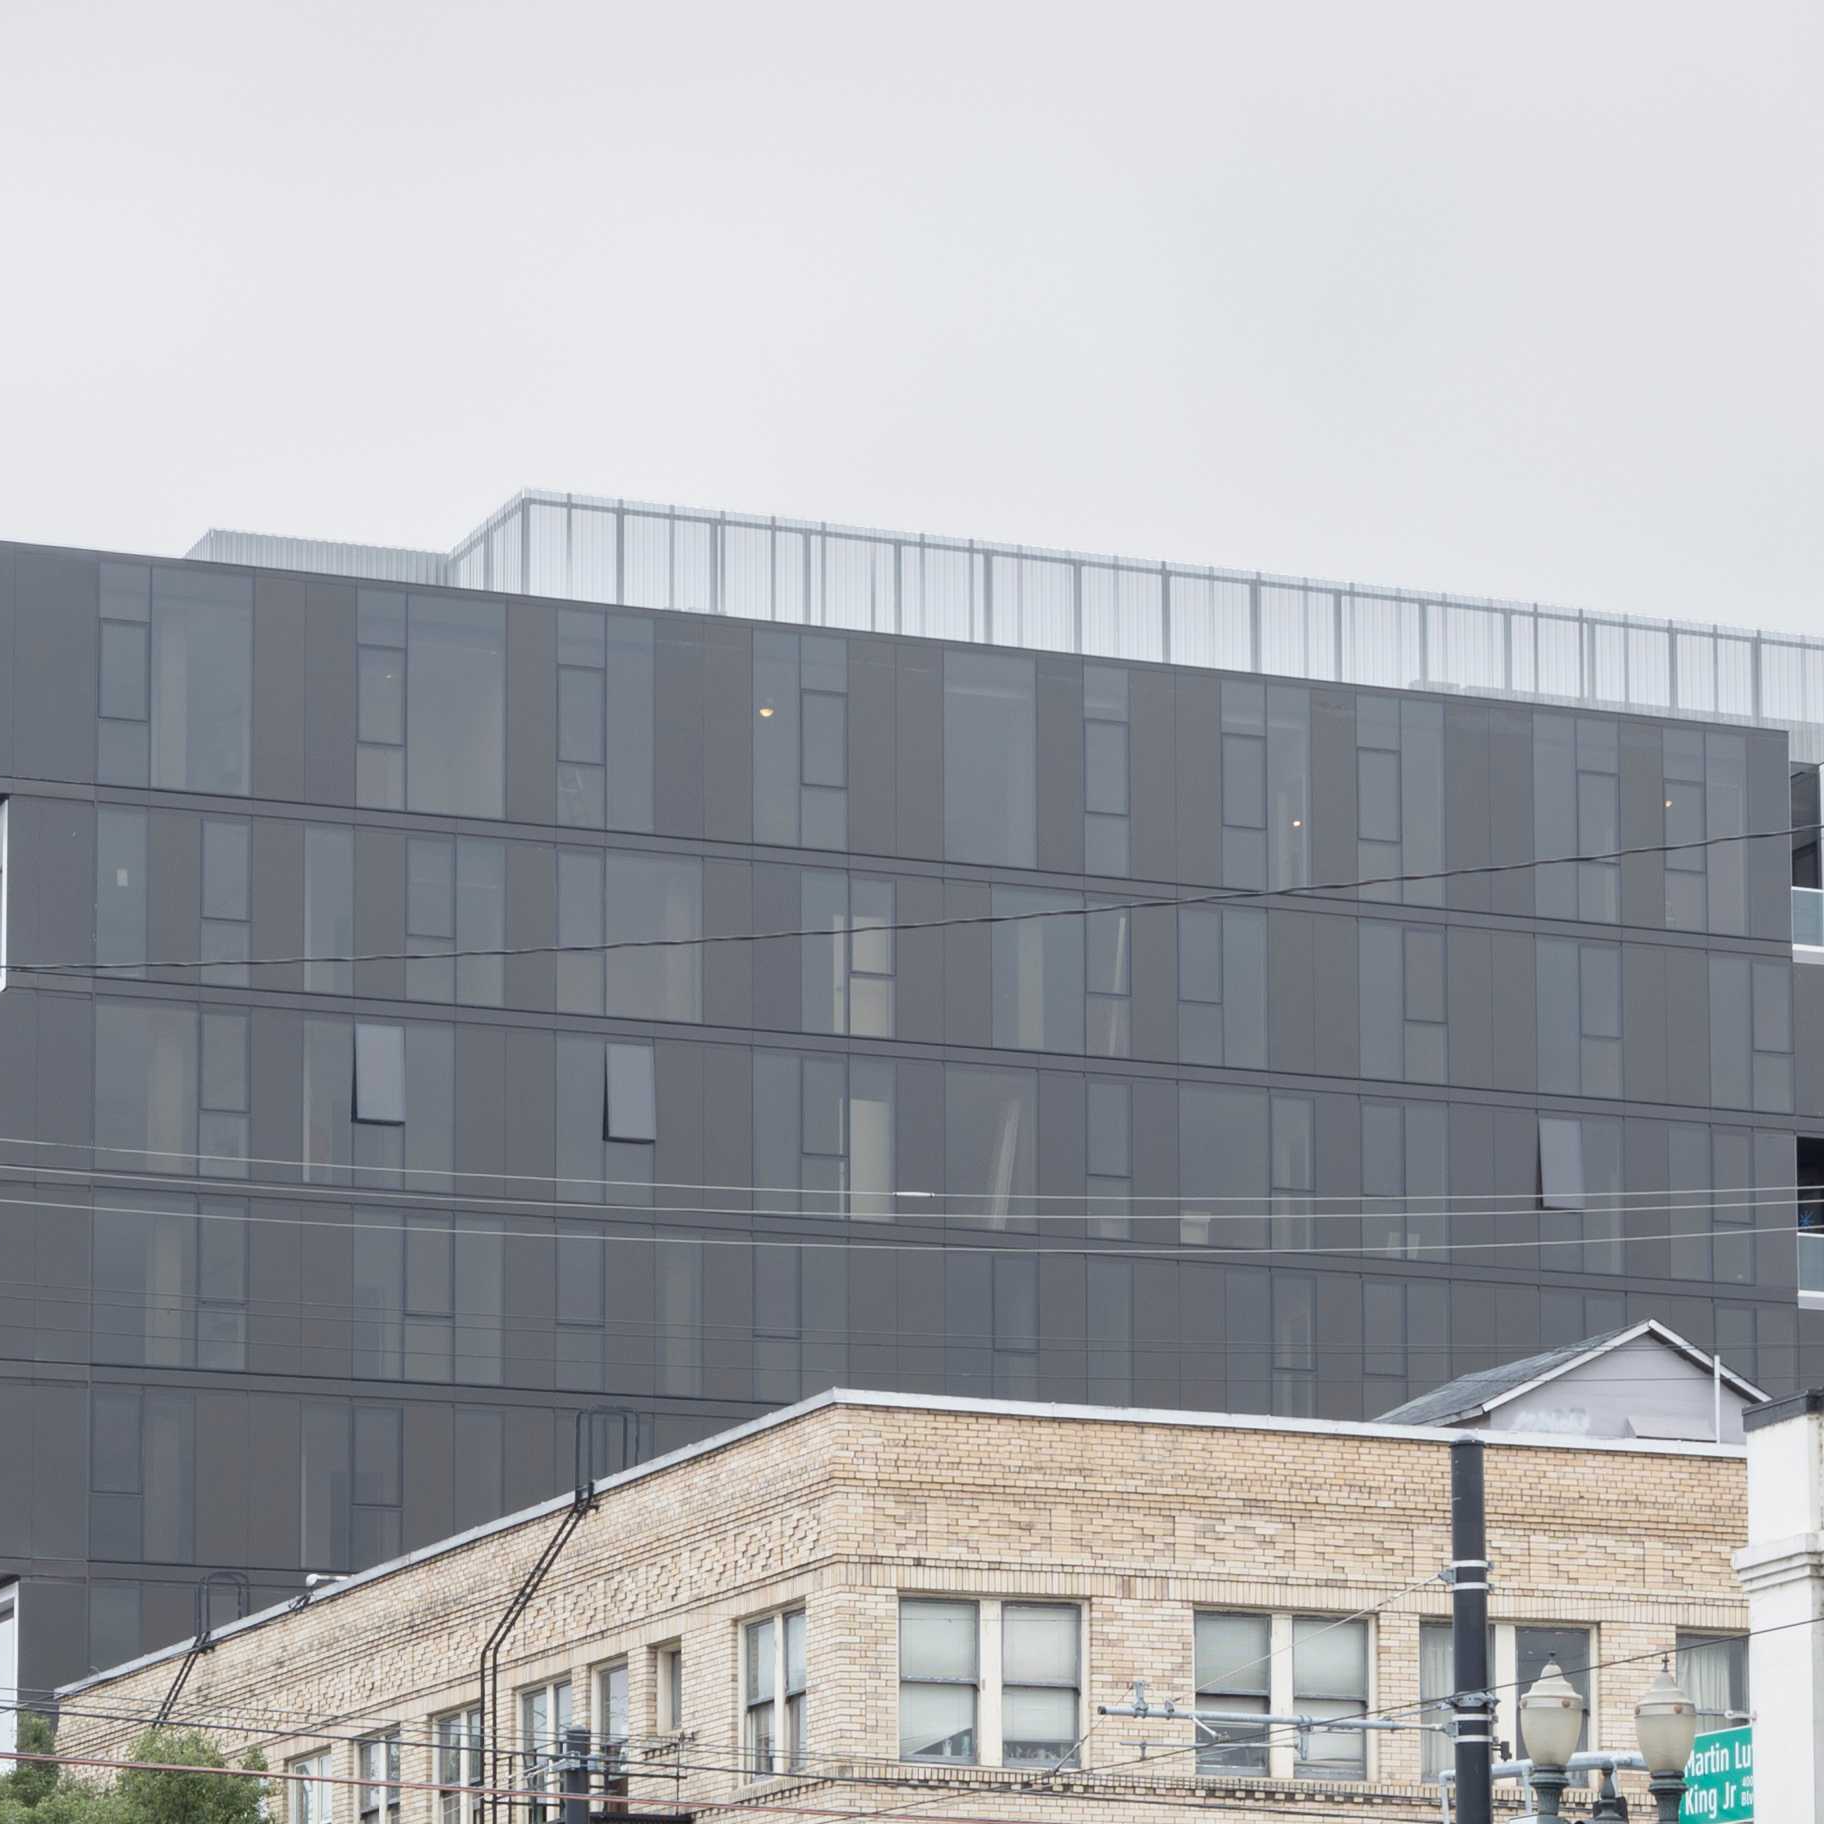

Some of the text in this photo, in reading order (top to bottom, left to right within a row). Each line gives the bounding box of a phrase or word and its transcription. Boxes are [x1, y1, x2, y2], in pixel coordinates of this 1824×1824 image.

[1684, 1741, 1753, 1777] Martin Lu
[1685, 1782, 1736, 1819] King Jr
